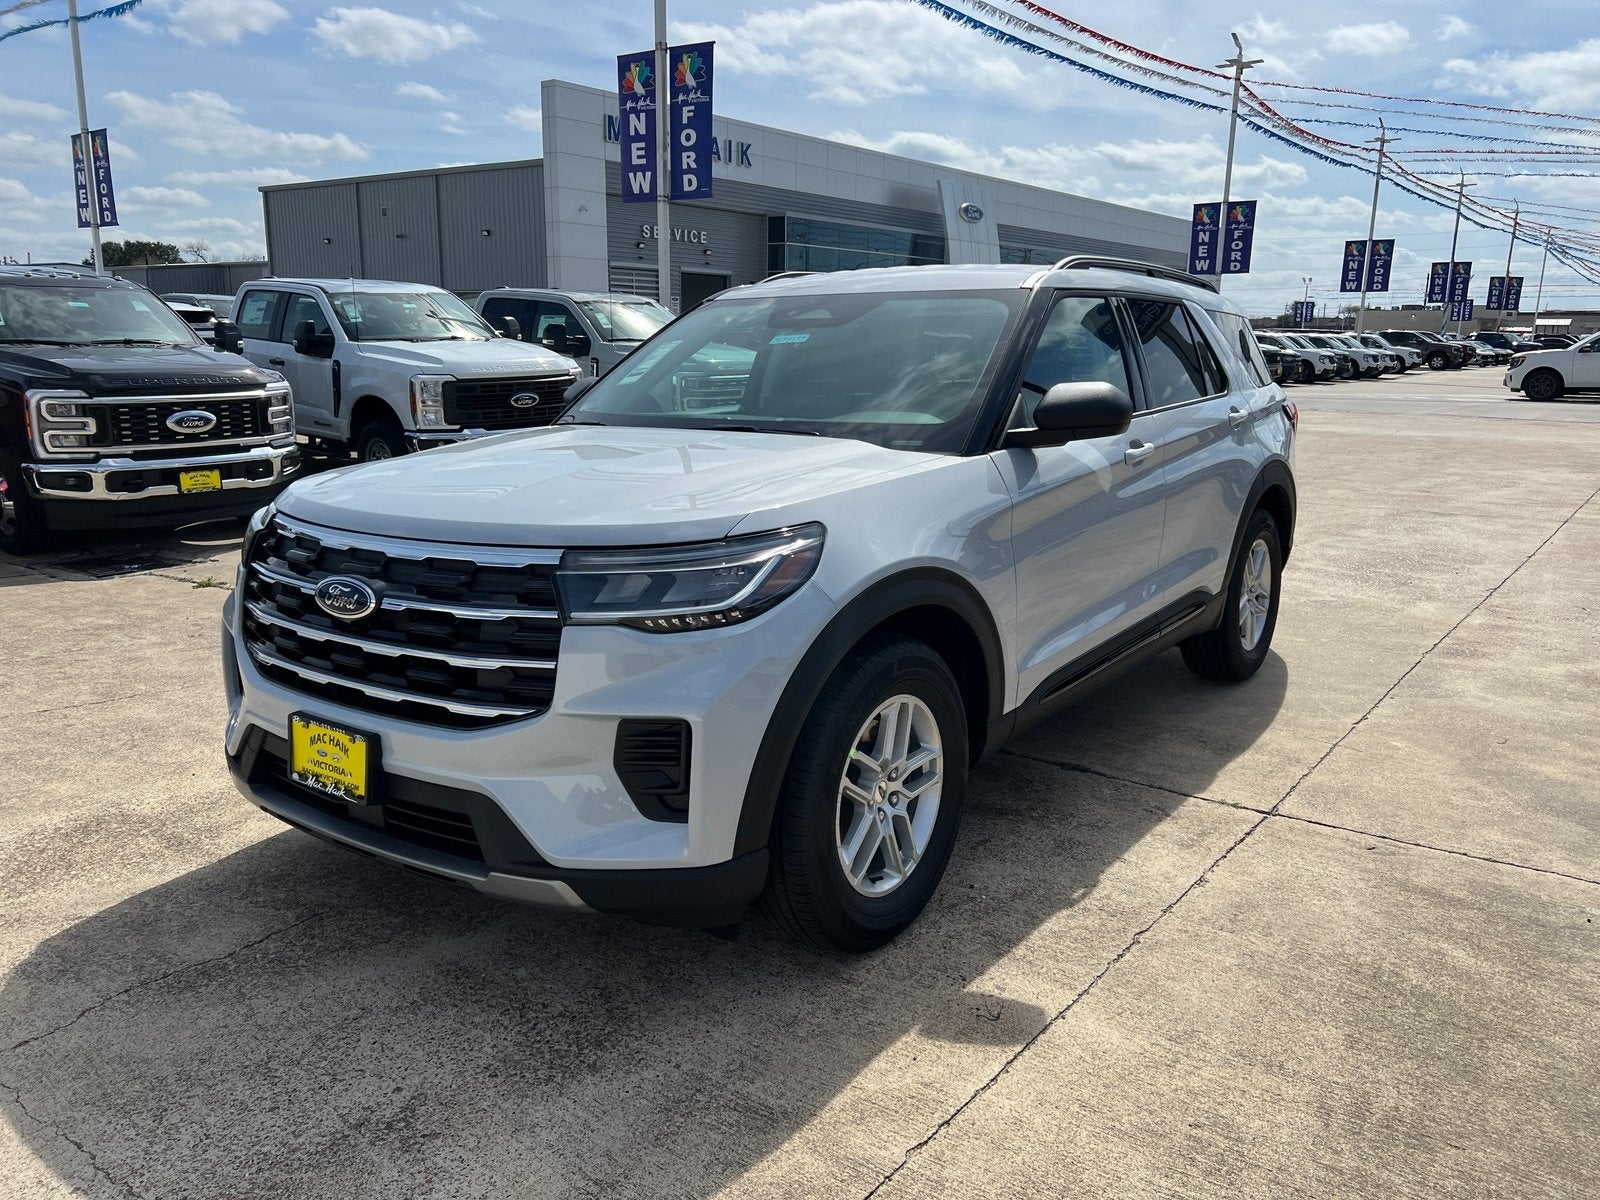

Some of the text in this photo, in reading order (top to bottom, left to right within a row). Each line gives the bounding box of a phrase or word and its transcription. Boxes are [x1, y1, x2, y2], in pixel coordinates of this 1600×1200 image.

[629, 113, 651, 194] NEW
[681, 106, 697, 191] FORD
[712, 136, 752, 167] AIK
[77, 171, 91, 222] NEW
[100, 169, 111, 222] FORD
[642, 225, 707, 243] SEVICE
[1195, 231, 1210, 271] NEW
[1230, 230, 1243, 271] FORD
[1345, 261, 1358, 290] NEW
[1373, 260, 1384, 290] FORD
[1432, 278, 1443, 301] NEW
[1454, 278, 1464, 301] FORD
[1489, 289, 1499, 309] NEW
[1508, 290, 1516, 309] FORD
[112, 375, 244, 386] SUPER DUTY
[518, 396, 532, 404] Ford
[182, 417, 205, 427] Ford
[325, 584, 358, 610] Ford
[310, 733, 327, 747] MAC
[329, 734, 350, 759] HAIK
[305, 775, 346, 797] Mac Haik
